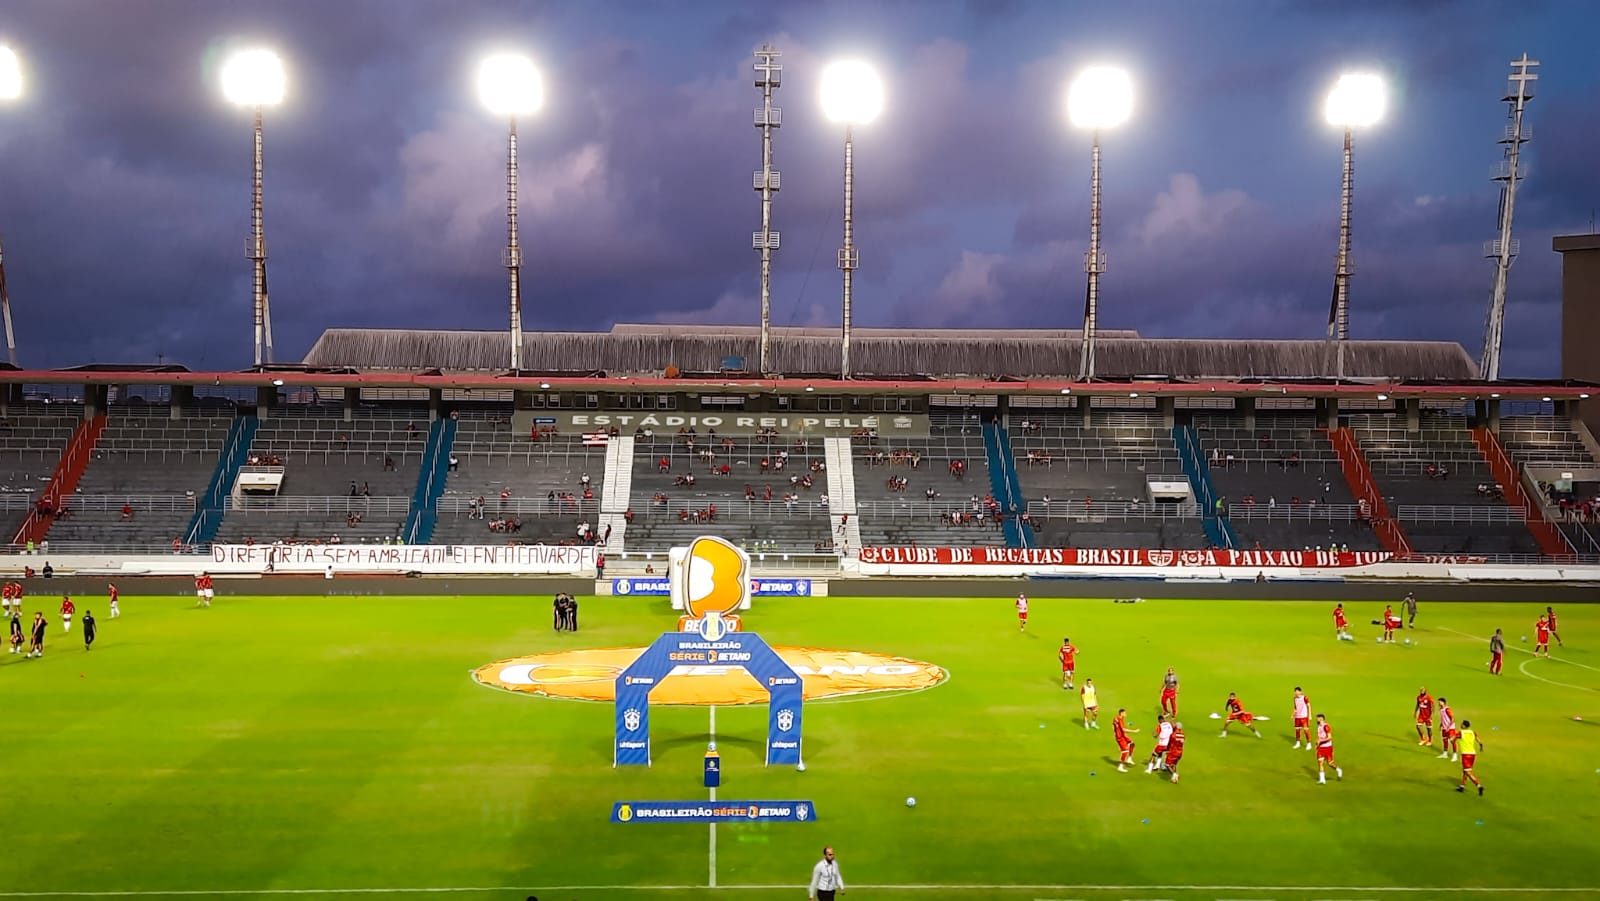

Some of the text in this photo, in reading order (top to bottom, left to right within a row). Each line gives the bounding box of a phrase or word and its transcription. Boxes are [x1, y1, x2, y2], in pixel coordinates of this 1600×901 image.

[571, 413, 723, 426] ESTÁDIO
[736, 416, 788, 427] REI
[802, 414, 878, 428] PELÉ
[323, 548, 360, 564] SEM
[881, 547, 1143, 565] CLUBE DE REGATAS BRASIL
[1315, 550, 1340, 566] DE
[679, 641, 741, 649] BRASILEIRÃO
[718, 652, 751, 661] BETANO
[636, 807, 712, 817] BRASILEIRÃO
[713, 807, 747, 817] SÉRIE
[759, 808, 791, 816] BETANO
